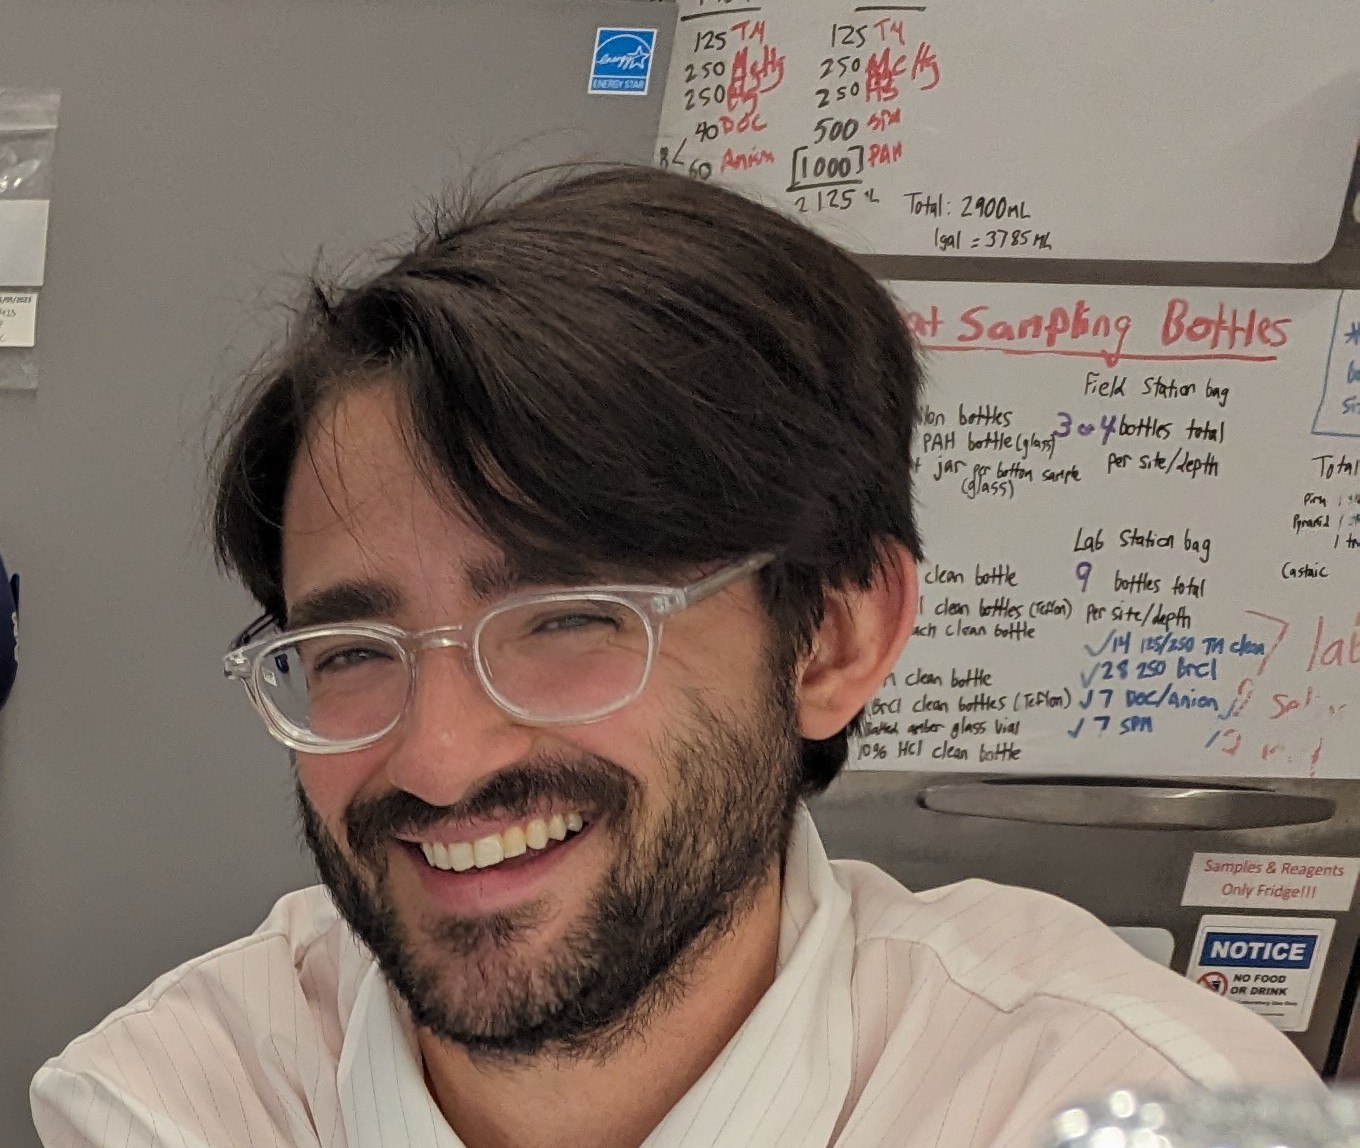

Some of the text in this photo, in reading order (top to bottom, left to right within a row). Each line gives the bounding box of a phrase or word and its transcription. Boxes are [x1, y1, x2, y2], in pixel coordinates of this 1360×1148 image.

[693, 30, 727, 53] 125
[831, 24, 868, 49] 125
[684, 60, 726, 83] 250
[819, 57, 860, 79] 250
[625, 79, 644, 88] STAR
[815, 82, 860, 109] 250
[685, 84, 726, 111] 250
[695, 114, 768, 144] 40 DOC
[813, 117, 859, 145] 500
[867, 140, 903, 168] PAH
[794, 189, 853, 213] 2125
[903, 191, 951, 219] Total:
[1161, 297, 1294, 350] Bottles
[1083, 371, 1231, 408] Field Station bag
[1118, 413, 1174, 441] bottles
[1185, 418, 1226, 444] total
[922, 430, 956, 453] PAH
[967, 430, 1014, 452] bottle
[933, 454, 968, 481] jar
[960, 477, 1016, 500] (glass)
[1073, 527, 1212, 564] Lab Station bag
[923, 563, 1019, 587] clean bottle
[1075, 561, 1206, 599] 9 bottles total
[945, 618, 987, 638] clean
[993, 621, 1037, 642] bottle
[904, 667, 943, 687] clean
[950, 667, 993, 689] bottle
[1136, 660, 1168, 681] 250
[912, 693, 949, 714] clean
[957, 692, 1008, 714] bottles
[949, 715, 987, 740] glass
[931, 740, 969, 761] clean
[978, 741, 1022, 764] bottle
[1203, 859, 1345, 880] Samples & Reagents
[1221, 882, 1255, 899] Only
[1210, 940, 1308, 962] NOTICE
[1233, 974, 1287, 984] NO FOOD
[1230, 986, 1288, 997] OR DRINK
